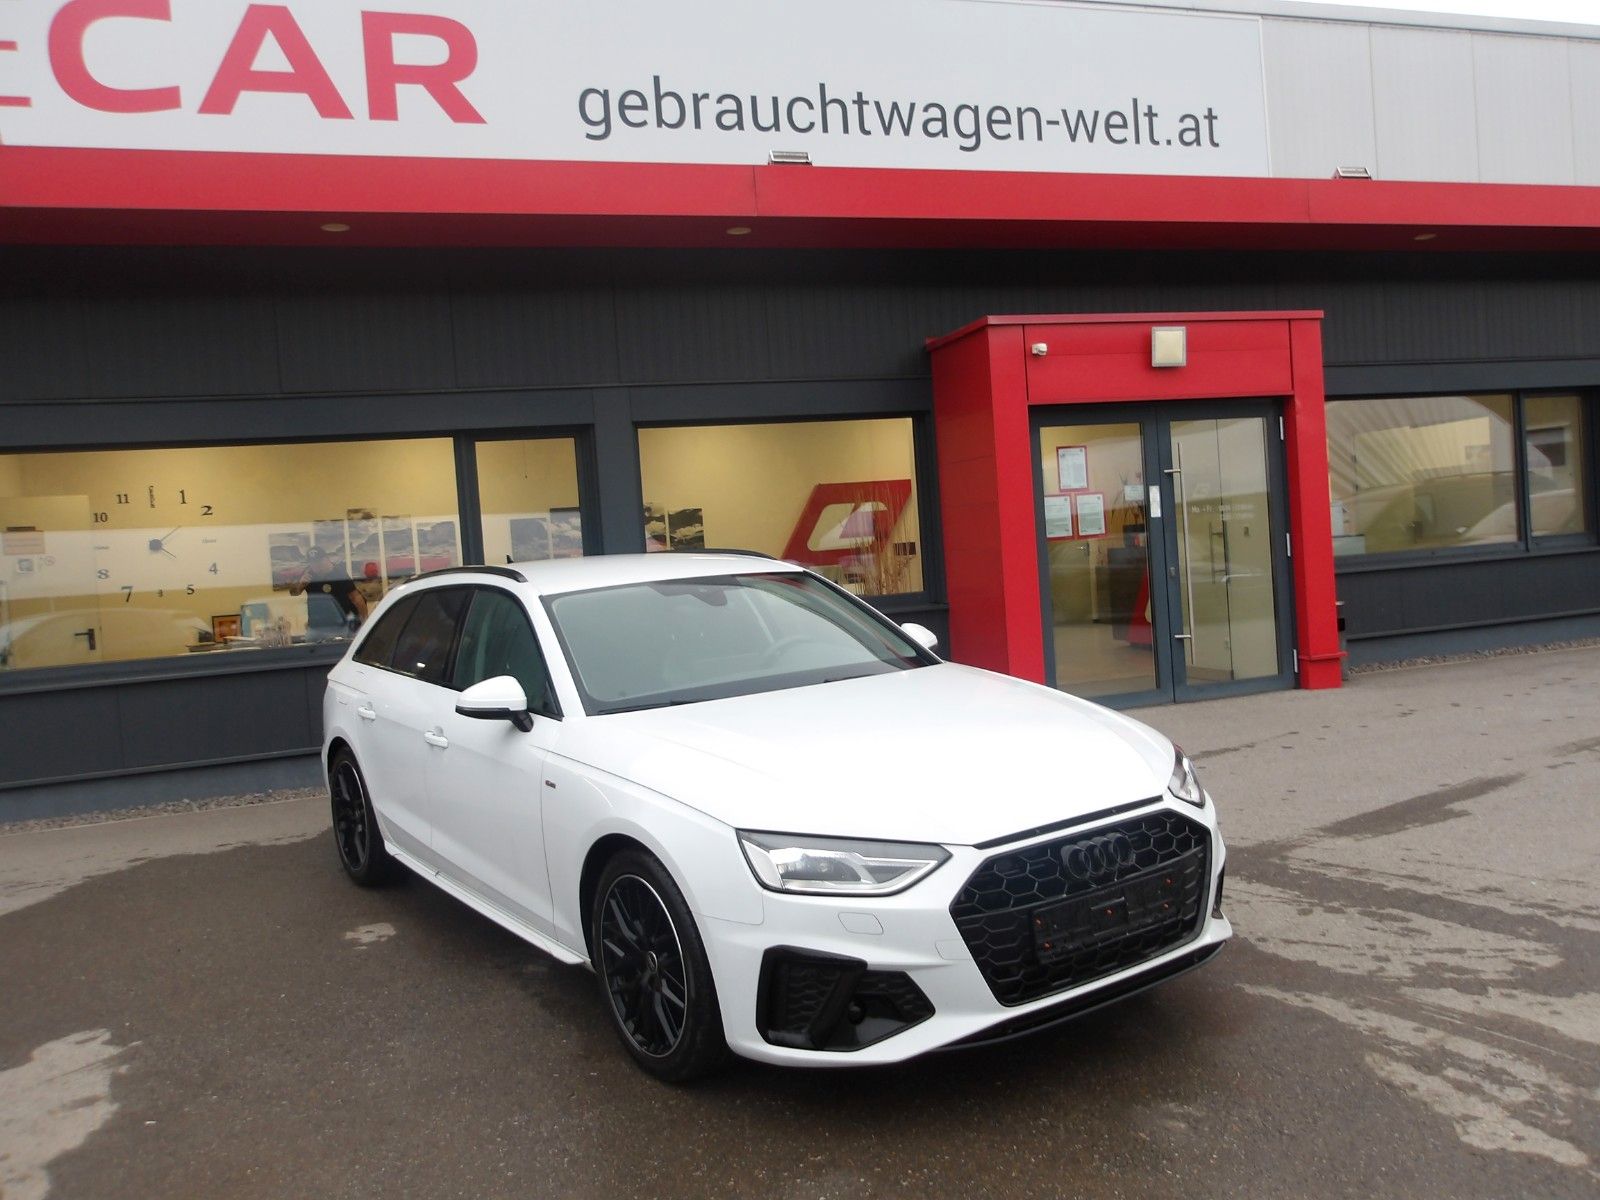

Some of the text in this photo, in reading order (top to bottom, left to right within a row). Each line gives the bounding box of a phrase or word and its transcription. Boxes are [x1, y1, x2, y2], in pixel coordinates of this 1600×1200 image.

[578, 75, 1220, 153] gebrauchtwagen-welt.at
[115, 493, 130, 505] 11
[179, 489, 187, 505] 1
[93, 511, 108, 523] 10
[200, 504, 214, 517] 2
[96, 568, 109, 580] 8
[208, 561, 218, 575] 4
[120, 585, 133, 603] 7
[186, 583, 195, 596] 5
